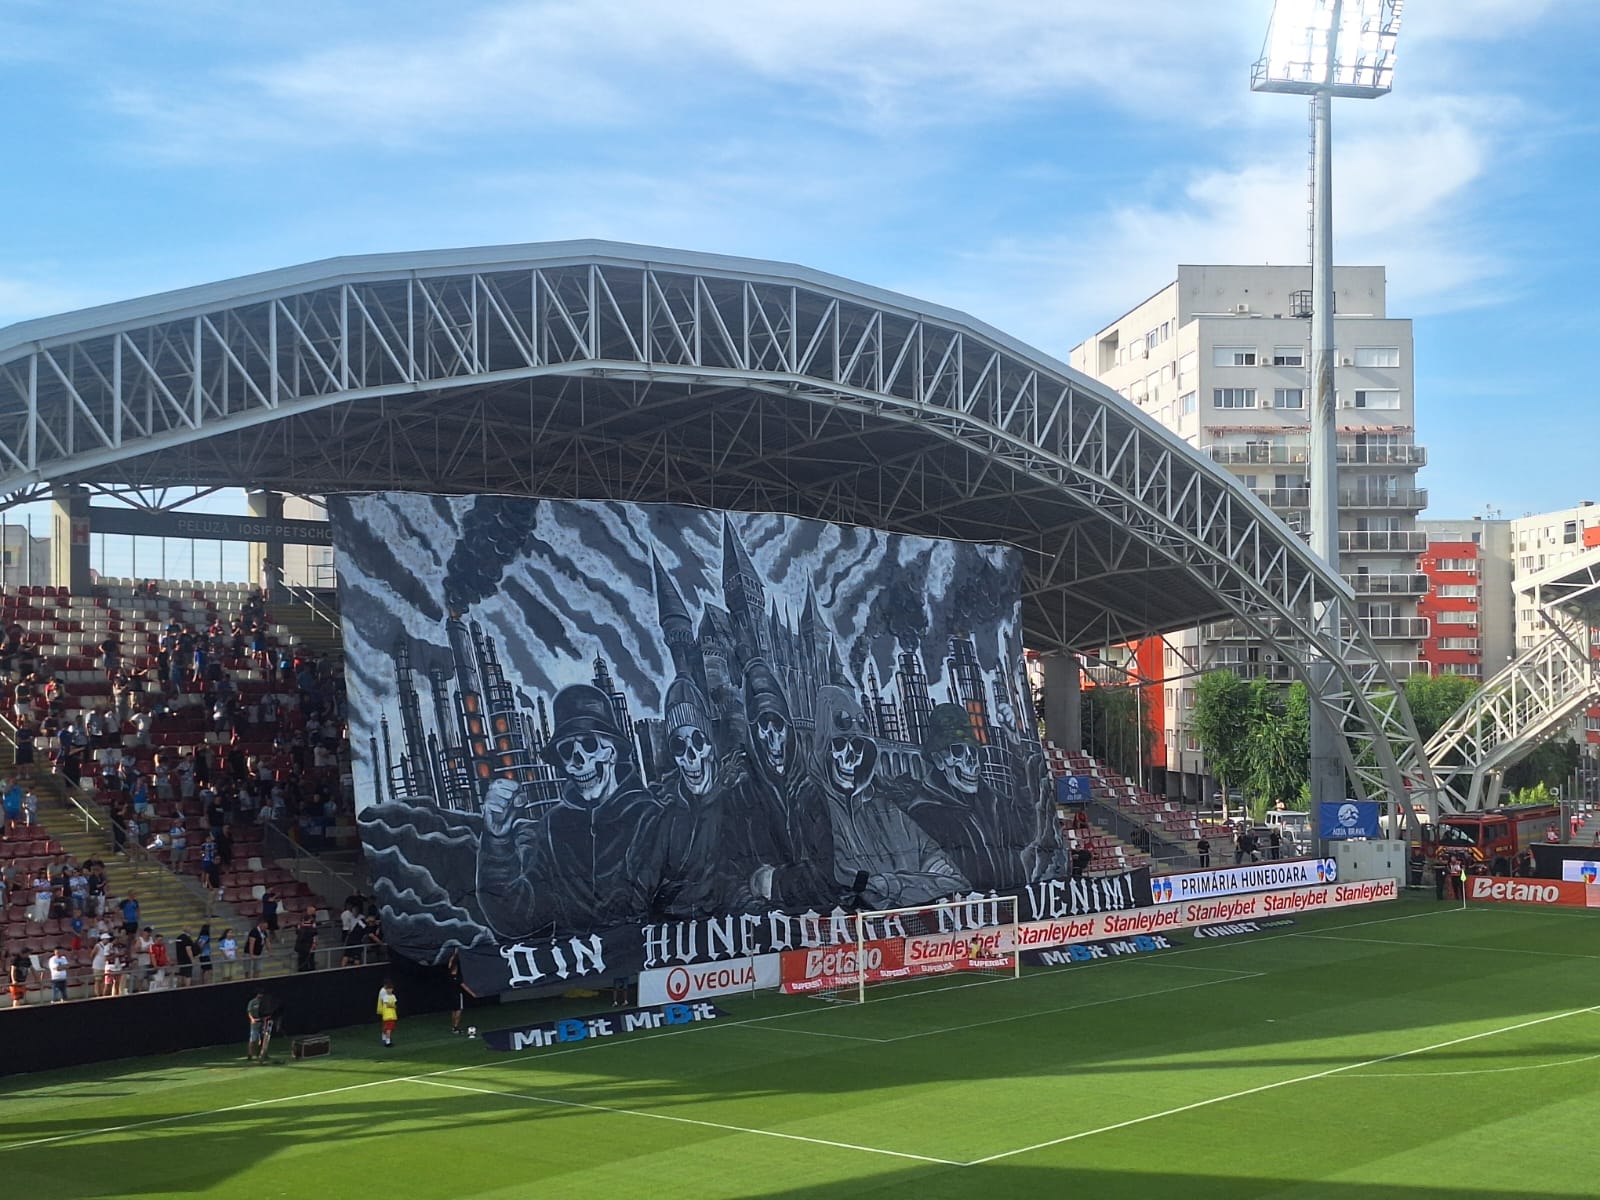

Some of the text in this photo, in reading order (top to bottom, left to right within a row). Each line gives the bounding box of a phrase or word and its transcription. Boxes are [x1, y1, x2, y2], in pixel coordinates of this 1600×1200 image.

[178, 519, 230, 534] PELUZA
[238, 523, 272, 537] IOSIF
[1181, 865, 1308, 896] PRIMĂRIA HUNEDOARA
[1472, 877, 1559, 903] Betano
[1025, 872, 1136, 921] VENIM!
[1103, 907, 1180, 934] Stanleybet
[1186, 896, 1256, 923] Stanleybet
[1263, 888, 1328, 912] Stanleybet
[1334, 880, 1394, 903] Stanleybet
[1203, 921, 1262, 938] UNIBET
[1042, 935, 1171, 966] MrBit MrBit
[693, 965, 757, 991] VEOLIA
[513, 1002, 717, 1050] MrBit MrBit
